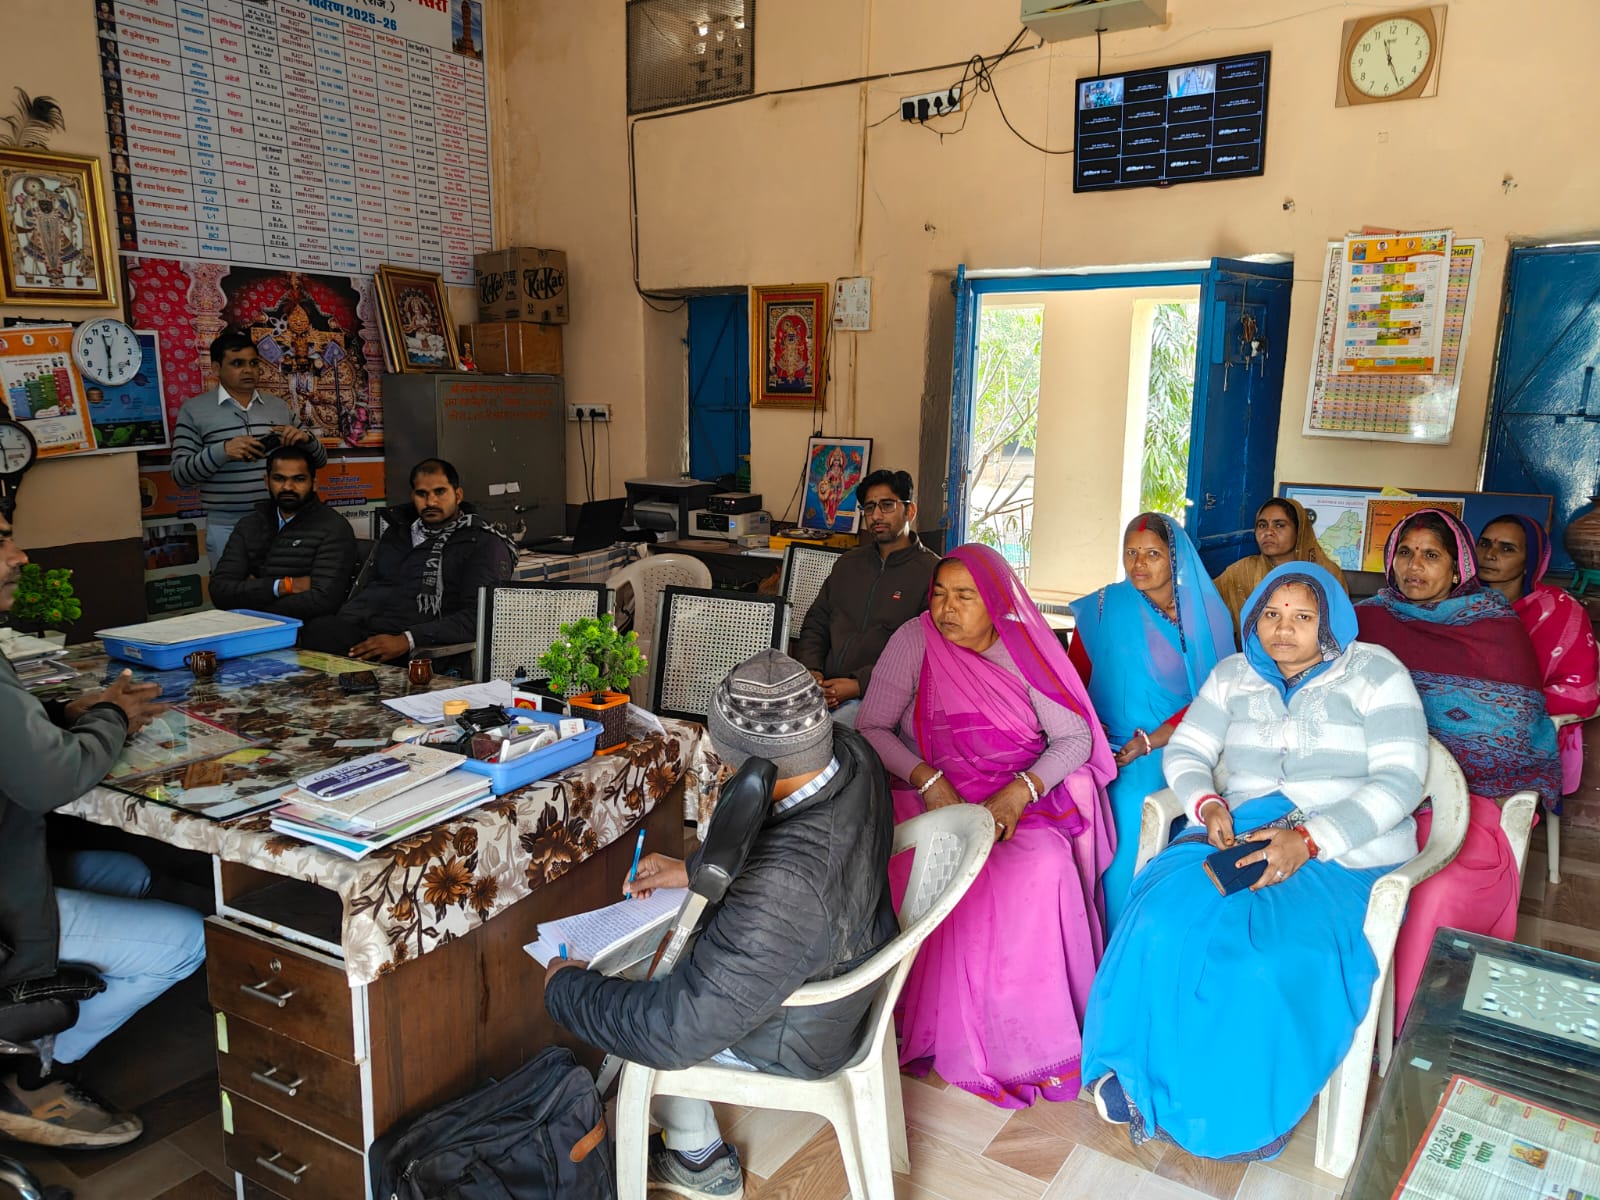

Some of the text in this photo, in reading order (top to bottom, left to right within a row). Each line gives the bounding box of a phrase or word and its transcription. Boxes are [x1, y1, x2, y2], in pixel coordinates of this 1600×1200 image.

[346, 6, 397, 31] 2025-26
[1390, 25, 1397, 34] 12
[1375, 32, 1381, 40] 11
[1415, 36, 1420, 45] 2
[1363, 43, 1371, 52] 10
[1417, 50, 1422, 59] 3
[1358, 58, 1364, 67] 9
[1412, 66, 1417, 74] 4
[1360, 72, 1366, 80] 8
[1370, 81, 1375, 90] 7
[1400, 76, 1404, 86] 5
[1384, 83, 1389, 91] 6
[524, 268, 562, 300] KitKat
[85, 337, 93, 345] 10
[123, 336, 129, 344] 2
[97, 368, 103, 376] 7
